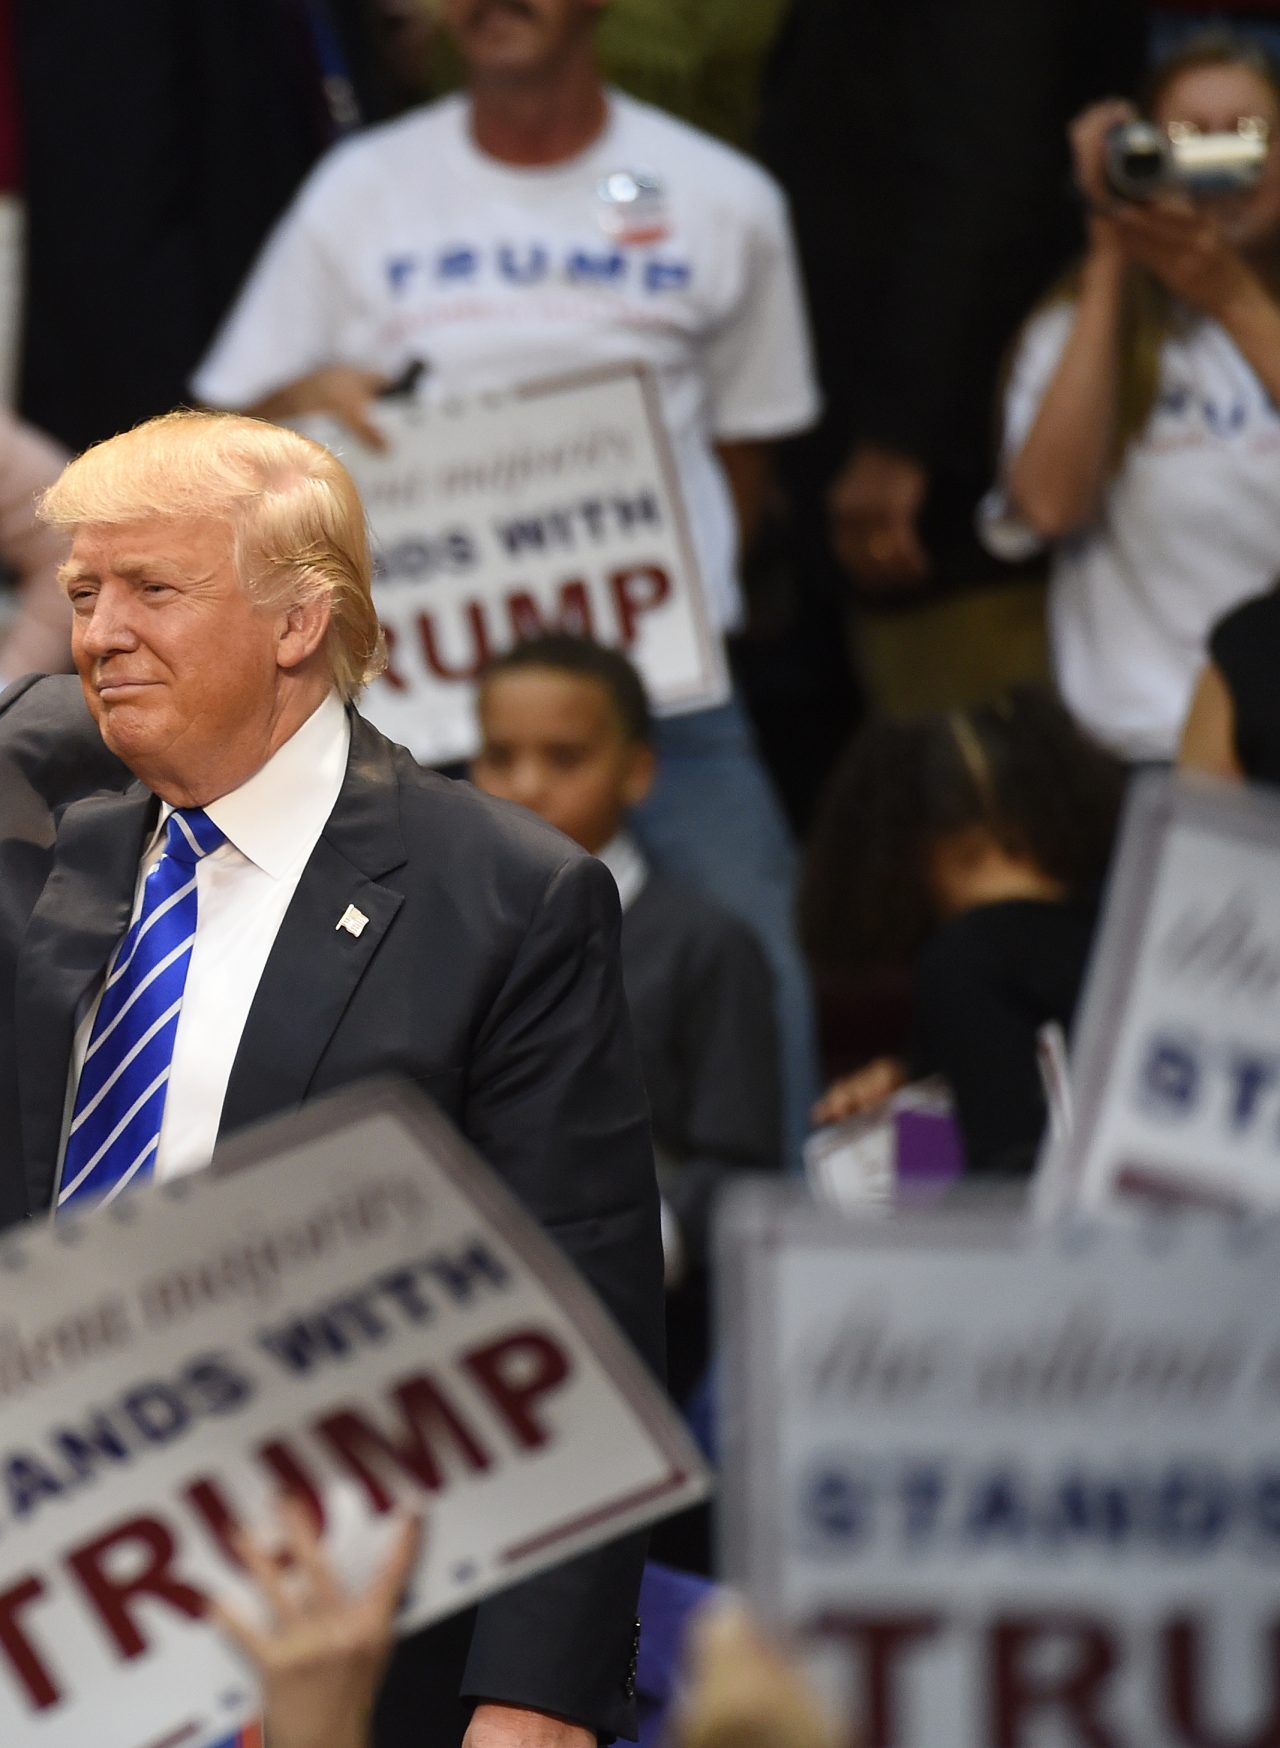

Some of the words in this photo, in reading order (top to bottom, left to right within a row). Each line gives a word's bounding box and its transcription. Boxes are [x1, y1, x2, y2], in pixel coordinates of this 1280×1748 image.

[384, 242, 692, 296] TRUMP
[492, 490, 662, 560] WITH
[257, 1236, 510, 1375] WITH
